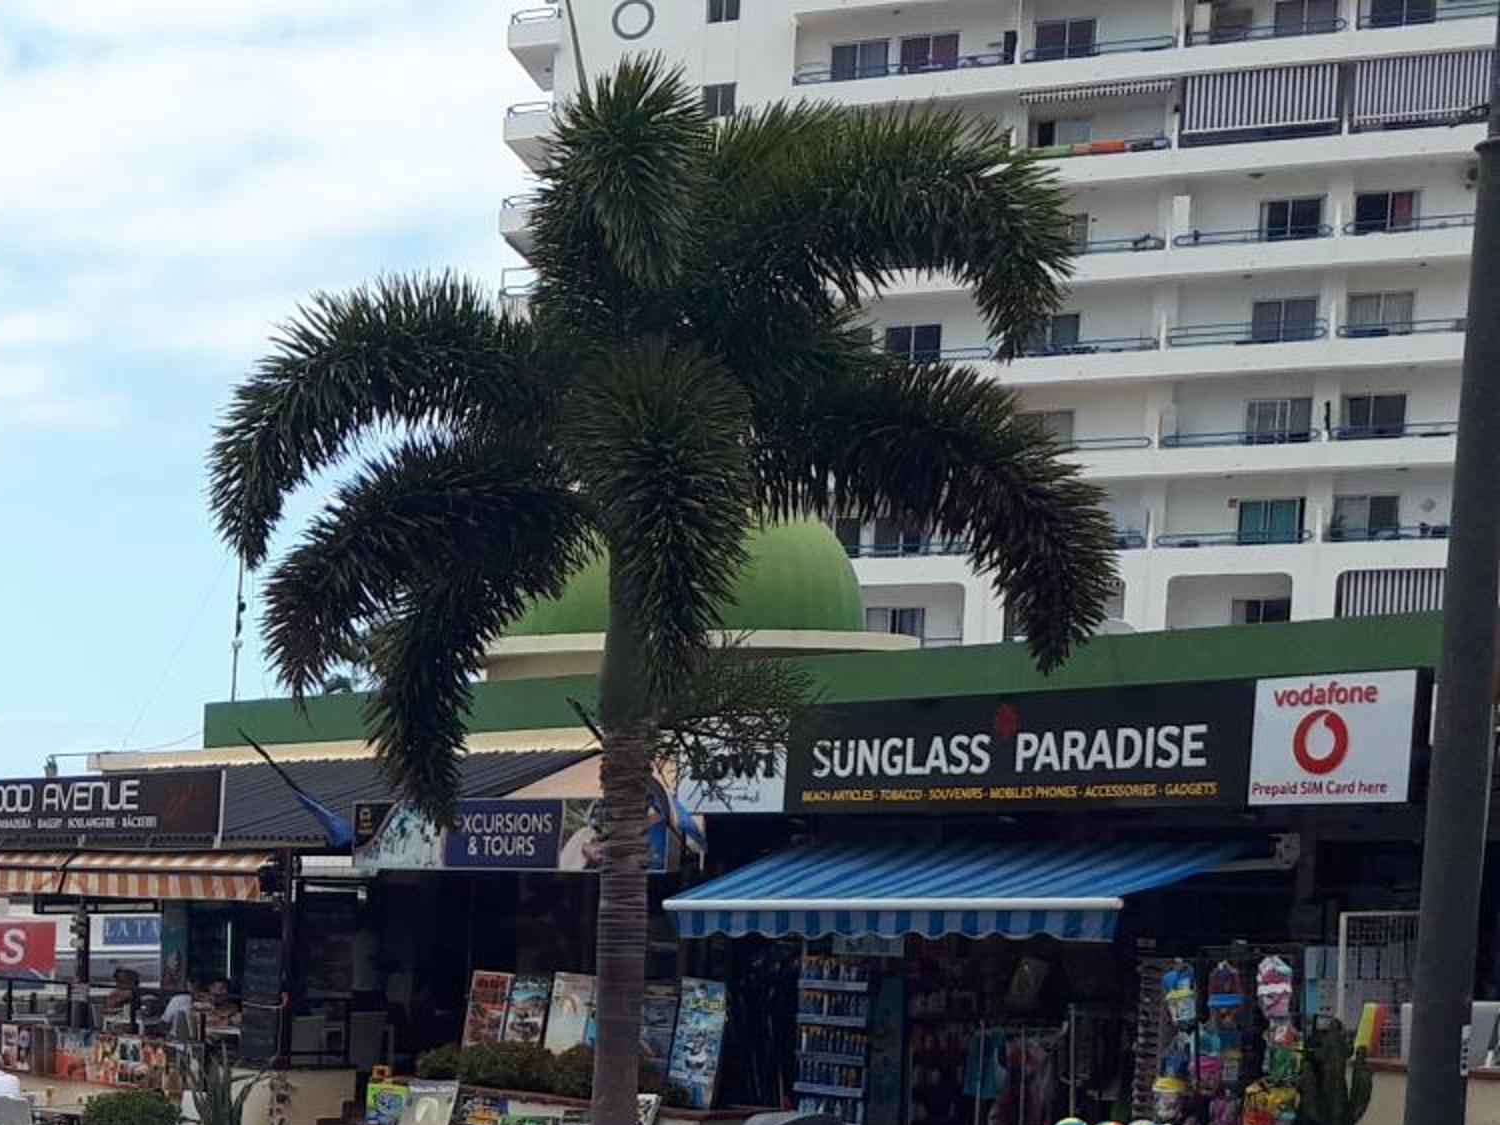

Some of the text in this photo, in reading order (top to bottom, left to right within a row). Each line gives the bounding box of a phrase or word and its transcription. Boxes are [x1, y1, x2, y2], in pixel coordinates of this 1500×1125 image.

[1274, 681, 1379, 706] vodafone
[812, 723, 1209, 777] SUNGLASS PARADISE
[42, 779, 141, 812] AVENUE
[803, 789, 831, 801] BEACH
[832, 789, 873, 801] ARTICLES
[880, 788, 923, 800] TOBACCO
[930, 787, 982, 800] SOUVENIRS
[1035, 785, 1077, 799] PHONES
[1084, 783, 1156, 798] ACCESSORIES
[1165, 781, 1218, 796] GADGETS
[1252, 779, 1388, 797] Prepaid SIM Card here
[467, 836, 535, 856] & TOURS
